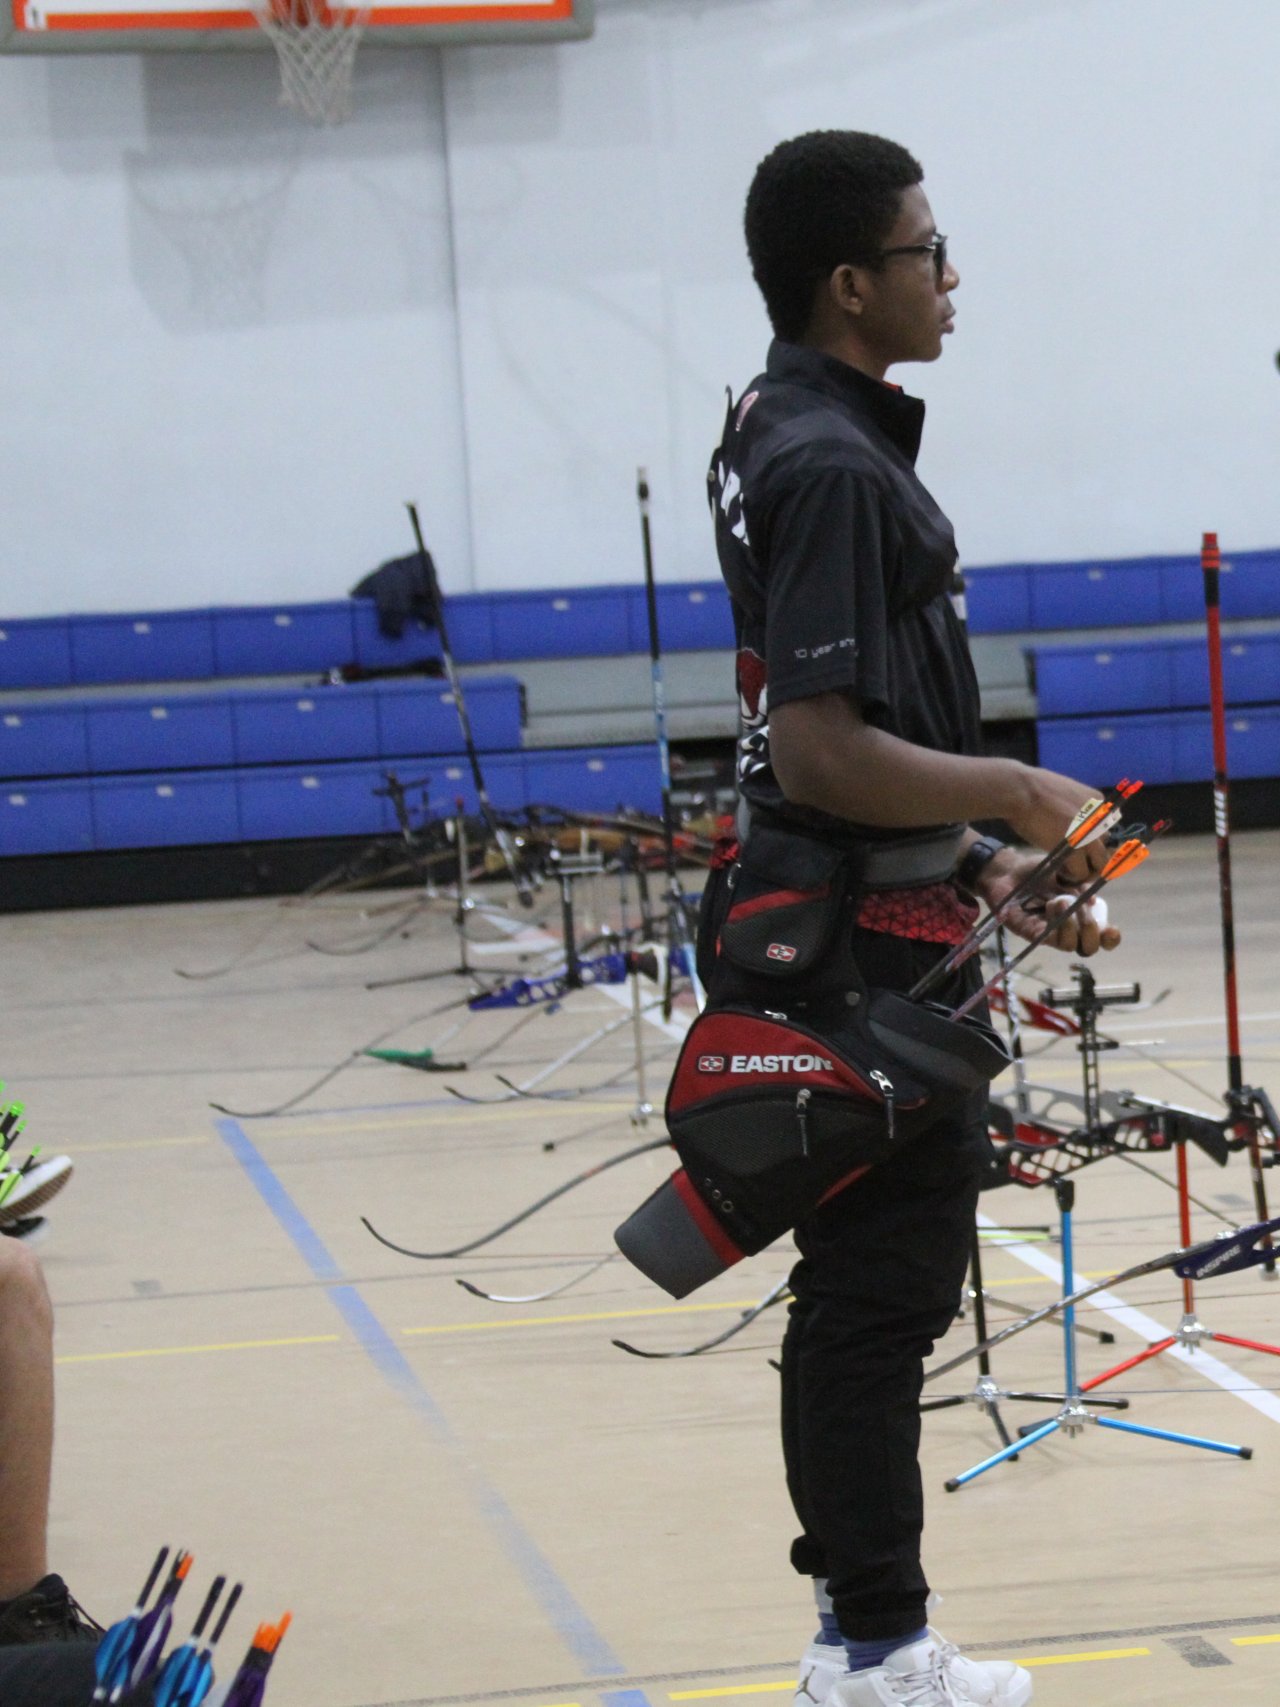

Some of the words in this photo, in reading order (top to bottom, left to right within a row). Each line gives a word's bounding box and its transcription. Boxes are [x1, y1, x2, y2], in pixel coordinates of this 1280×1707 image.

[811, 642, 836, 659] year
[730, 1054, 834, 1073] EASTON
[1196, 1244, 1241, 1278] INSPIRE
